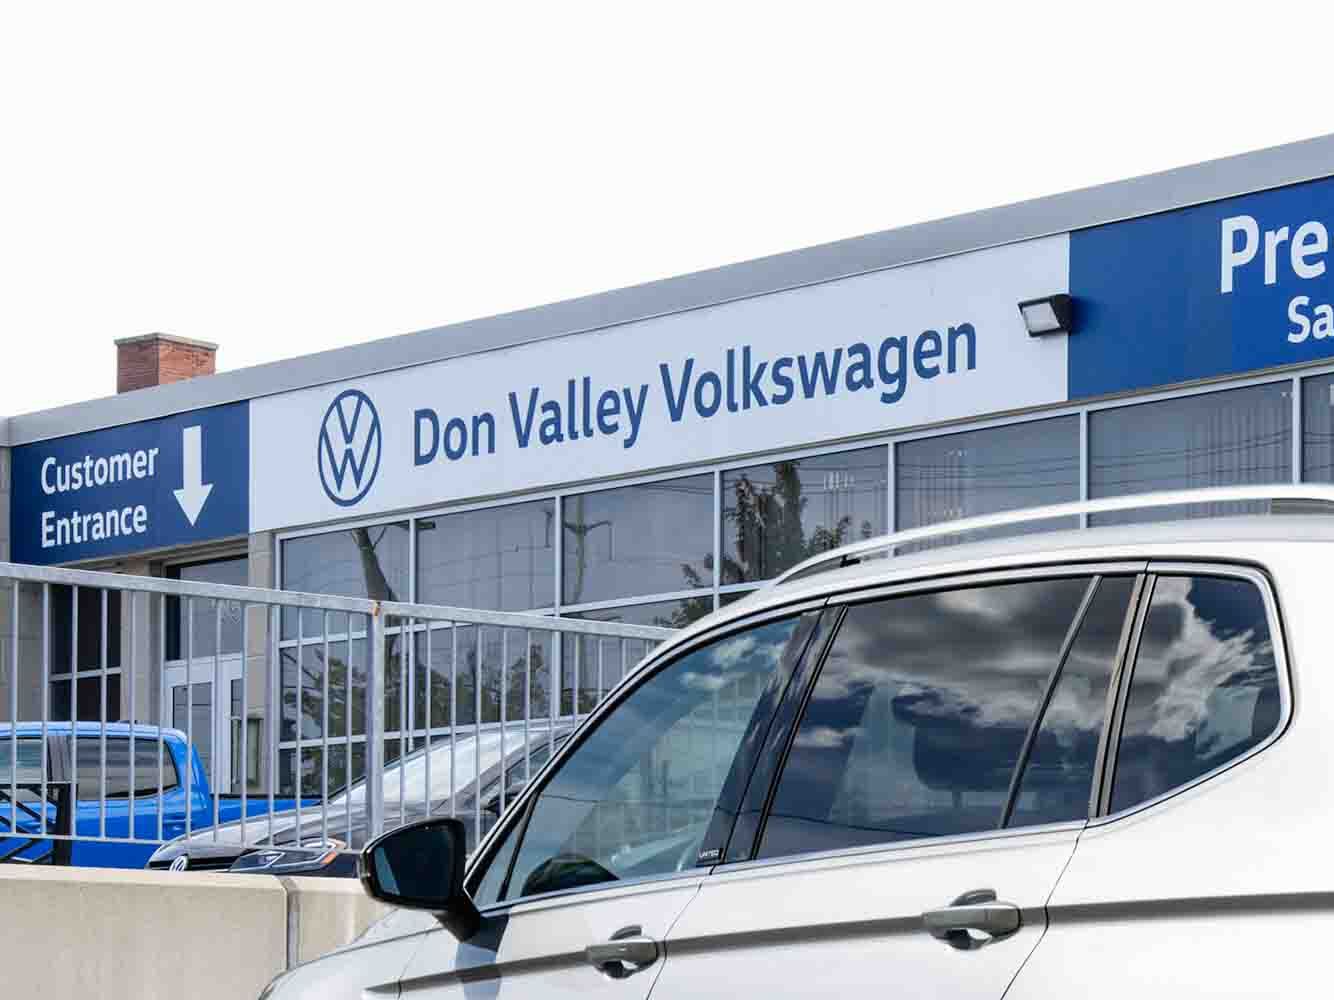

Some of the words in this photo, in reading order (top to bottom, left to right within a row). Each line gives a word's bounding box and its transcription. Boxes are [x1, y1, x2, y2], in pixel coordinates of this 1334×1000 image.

[413, 408, 496, 467] Don
[508, 376, 649, 450] Valley
[659, 321, 977, 404] Volkswagen
[41, 447, 159, 495] Customer
[41, 504, 148, 549] Entrance
